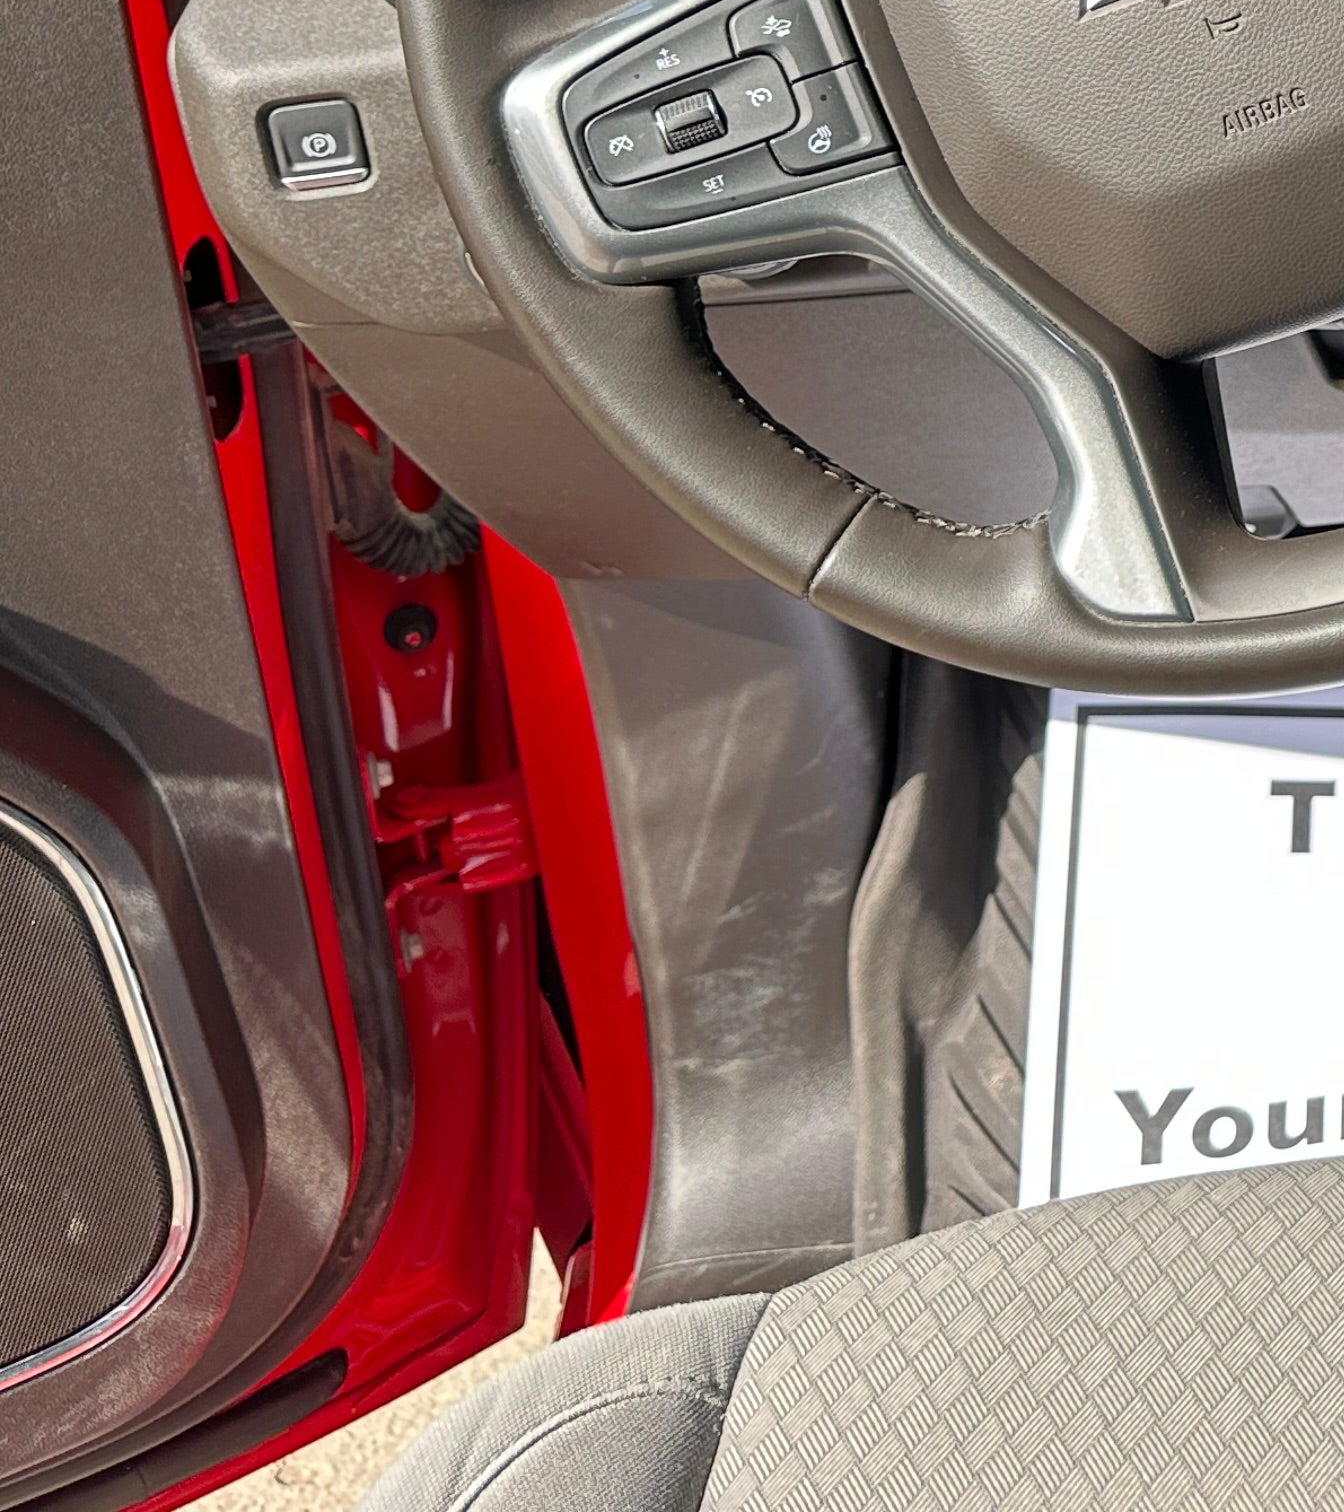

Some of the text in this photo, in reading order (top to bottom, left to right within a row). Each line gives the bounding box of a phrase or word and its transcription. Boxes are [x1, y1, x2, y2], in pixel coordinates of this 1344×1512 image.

[655, 54, 681, 70] RES
[1222, 87, 1309, 139] AIRBAG
[702, 174, 725, 193] SET
